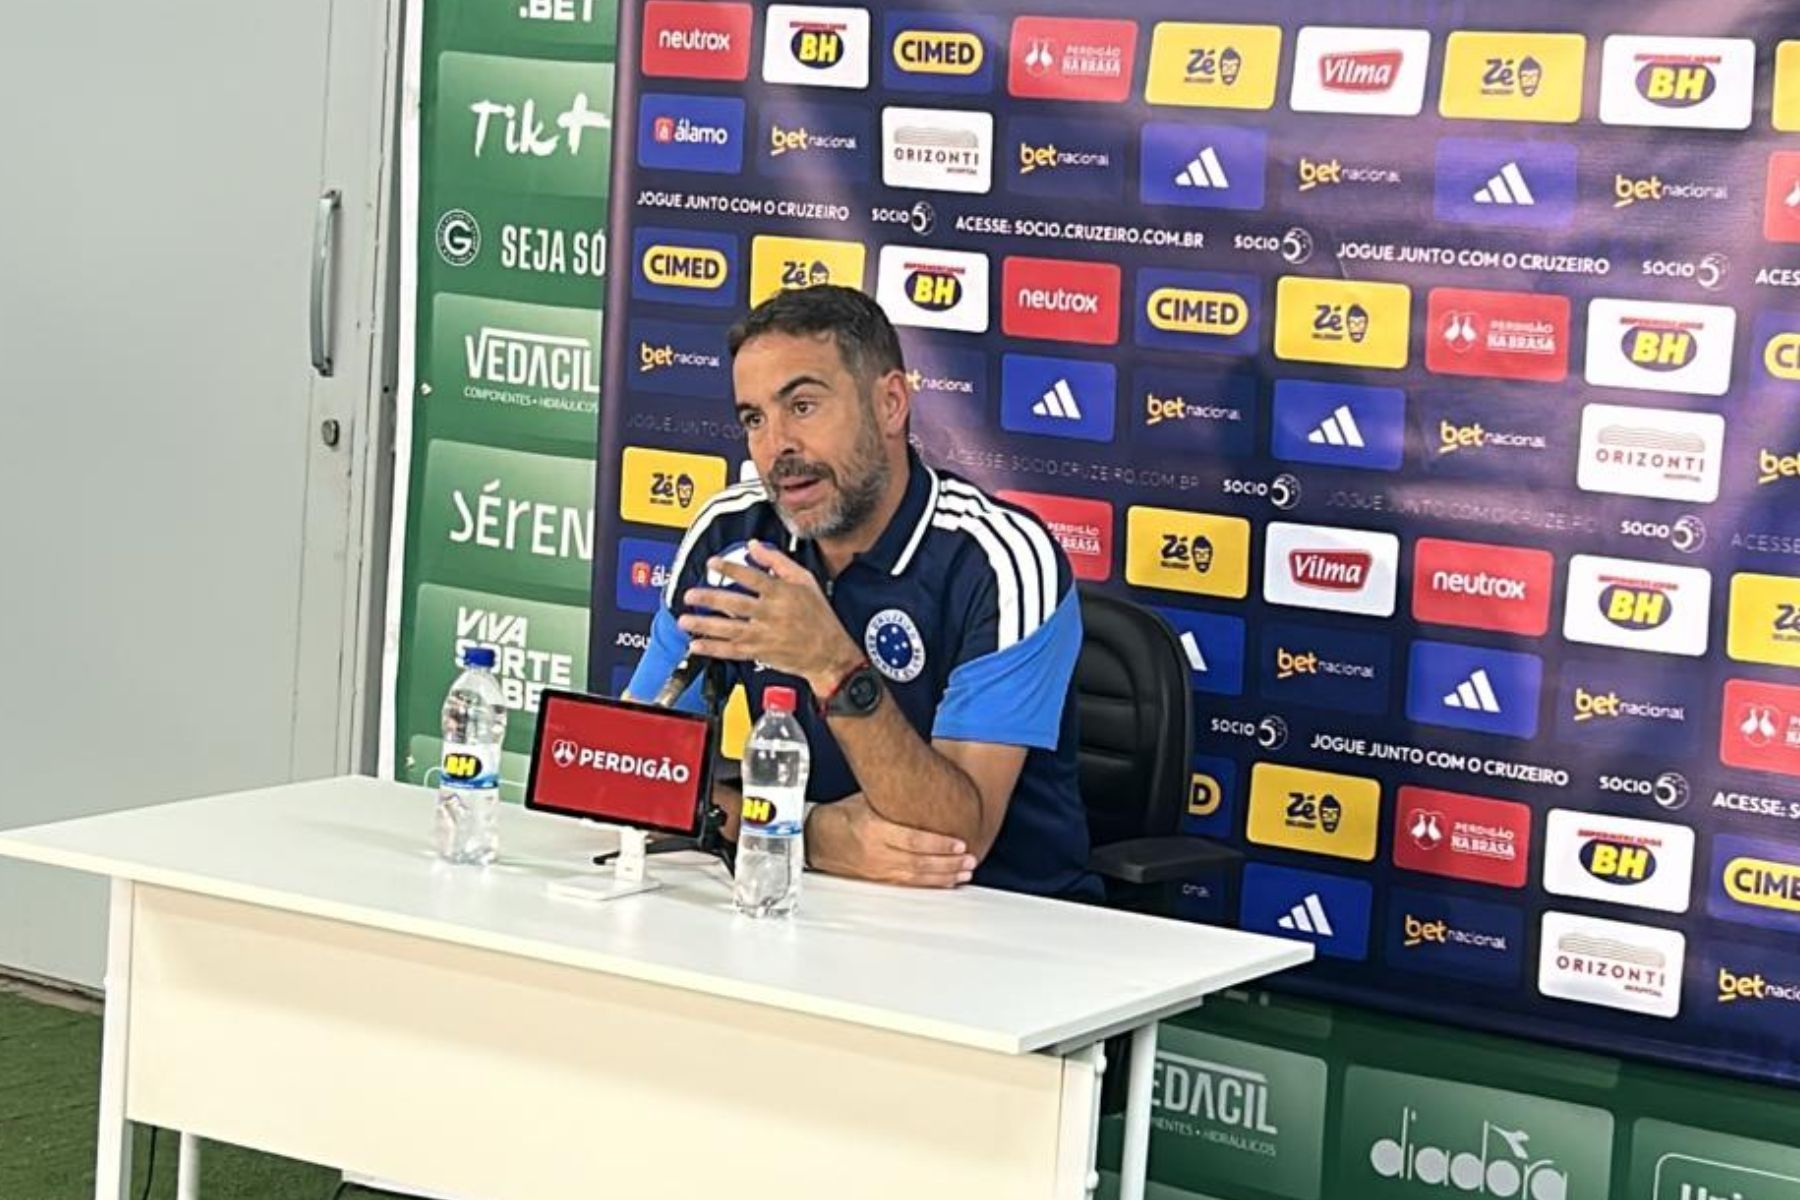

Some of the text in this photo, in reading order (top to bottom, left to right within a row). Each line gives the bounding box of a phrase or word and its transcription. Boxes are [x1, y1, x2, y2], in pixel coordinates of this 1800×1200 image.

[658, 28, 731, 51] neutrox
[799, 33, 838, 63] BH
[901, 40, 975, 65] CIMED
[1186, 48, 1216, 75] Zé
[1323, 56, 1392, 85] Vilma
[1482, 58, 1515, 86] Zé
[1647, 67, 1708, 100] BH
[675, 118, 728, 145] álamo
[894, 148, 980, 166] ORIZONTI
[637, 191, 850, 221] JOGUE JUNTO COM O CRUZEIRO
[871, 208, 909, 224] SOCIO
[955, 215, 1204, 248] ACESSE: SOCIO.CRUZEIRO.COM.BR
[1233, 234, 1280, 251] SOCIO
[501, 224, 566, 274] SEJA
[572, 228, 607, 277] SÓ
[1336, 243, 1611, 275] JOGUE JUNTO COM O CRUZEIRO
[650, 254, 720, 280] CIMED
[781, 261, 808, 286] Zé
[1642, 260, 1696, 278] SOCIO
[913, 274, 956, 306] BH
[1018, 287, 1099, 313] neutrox
[1155, 297, 1239, 325] CIMED
[1313, 304, 1344, 331] Zé
[464, 326, 600, 394] VEDACIL
[1631, 331, 1691, 365] BH
[1595, 447, 1705, 473] ORIZONTI
[650, 473, 674, 498] Zé
[1223, 478, 1269, 497] SOCIO
[1620, 519, 1670, 538] SOCIO
[1161, 534, 1190, 562] Zé
[1294, 555, 1362, 585] Vilma
[1432, 571, 1527, 600] neutrox
[1607, 589, 1664, 625] BH
[456, 607, 528, 648] VIVA
[616, 633, 651, 649] JOGU
[1211, 718, 1255, 737] SOCIO
[446, 756, 477, 777] BH
[578, 747, 690, 784] PERDIGÃO
[1311, 734, 1570, 786] JOGUE JUNTO COM O CRUZEIRO
[1599, 775, 1652, 795] SOCIO
[743, 797, 771, 821] BH
[1285, 792, 1317, 821] Zé
[1712, 792, 1786, 817] ACESSE:
[1590, 844, 1649, 880] BH
[1733, 867, 1800, 900] CIME
[1556, 955, 1666, 987] ORIZONTI
[1152, 1061, 1277, 1135] DACIL
[1370, 1107, 1568, 1200] diadora
